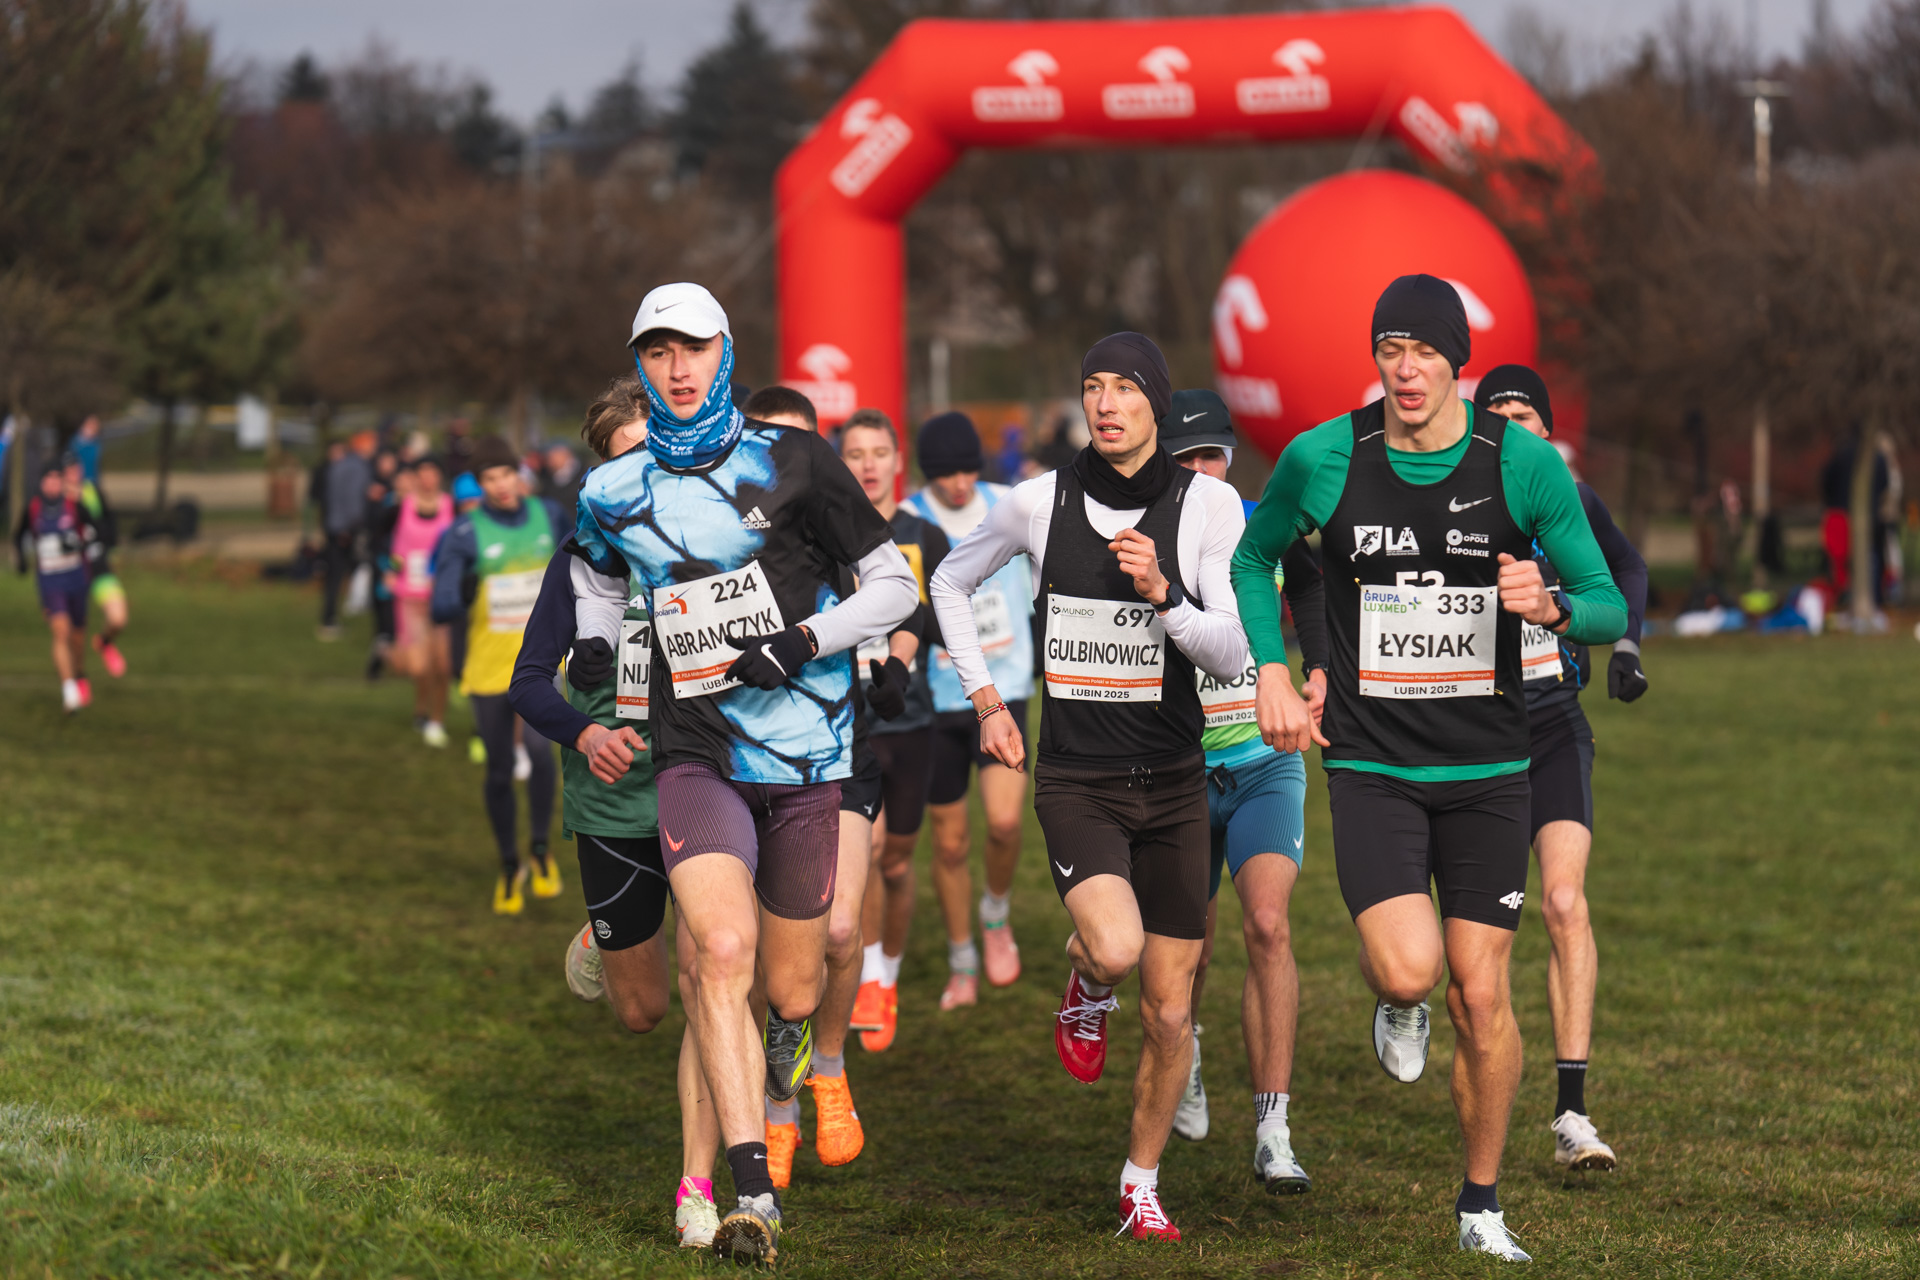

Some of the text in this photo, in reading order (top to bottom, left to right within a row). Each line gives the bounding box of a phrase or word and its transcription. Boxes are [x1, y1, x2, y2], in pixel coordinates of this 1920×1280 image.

[739, 521, 771, 530] adidas
[1464, 536, 1489, 544] OPOLE
[1451, 547, 1490, 558] OPOLSKIE
[710, 572, 758, 604] 224
[1364, 592, 1400, 603] GRUPA
[1364, 602, 1407, 614] LUXMED
[1437, 594, 1484, 614] 333
[654, 606, 680, 619] polanik
[1062, 608, 1094, 616] MUNDO
[1114, 608, 1155, 628] 697
[666, 607, 778, 658] ABRAMCZYK
[1378, 633, 1476, 658] ŁYSIAK
[1048, 638, 1160, 666] GULBINOWICZ
[1071, 688, 1130, 698] LUBIN 2025
[1394, 685, 1458, 695] LUBIN 2025
[1206, 714, 1233, 724] LUBIN
[1499, 891, 1524, 910] 4F
